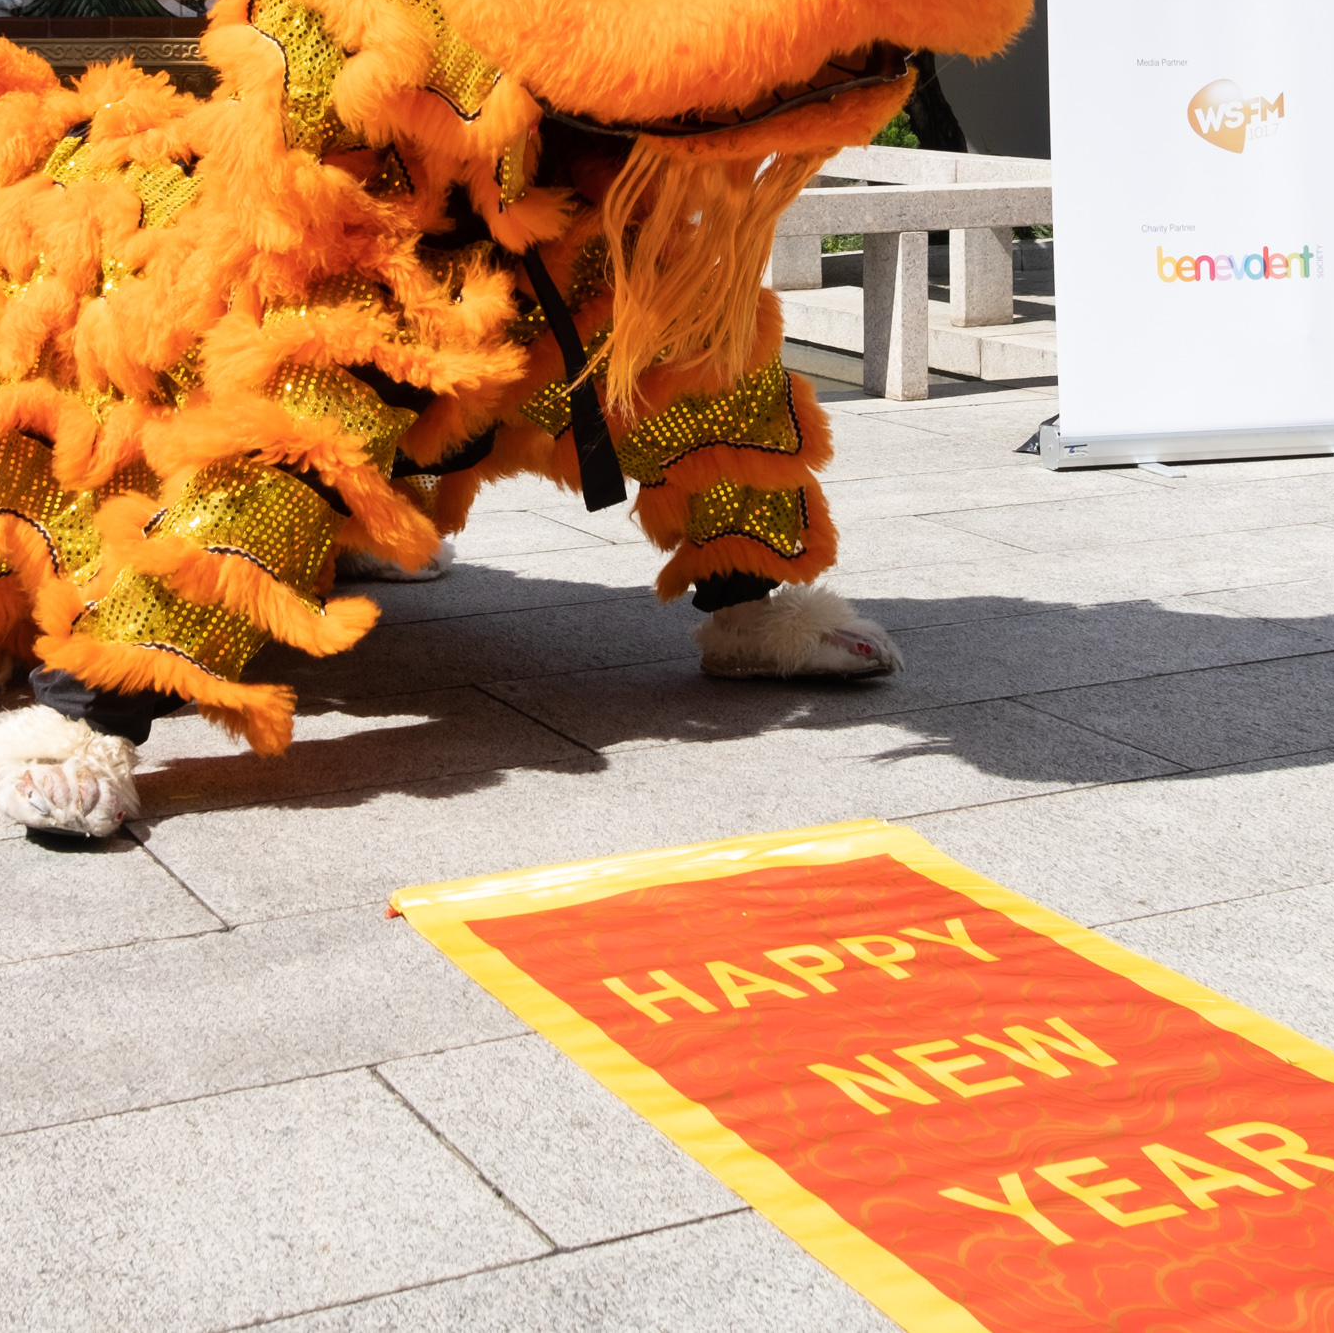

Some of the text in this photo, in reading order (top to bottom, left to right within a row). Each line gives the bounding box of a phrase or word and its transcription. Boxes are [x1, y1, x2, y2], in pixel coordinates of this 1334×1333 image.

[1136, 59, 1188, 67] Media Partner
[1194, 92, 1285, 134] WSFM
[1141, 224, 1196, 234] Charity Partner
[1156, 244, 1314, 284] benevolent
[1316, 244, 1324, 279] SOCIETY
[602, 918, 1001, 1025] HAPPY
[806, 1018, 1119, 1115] NEW
